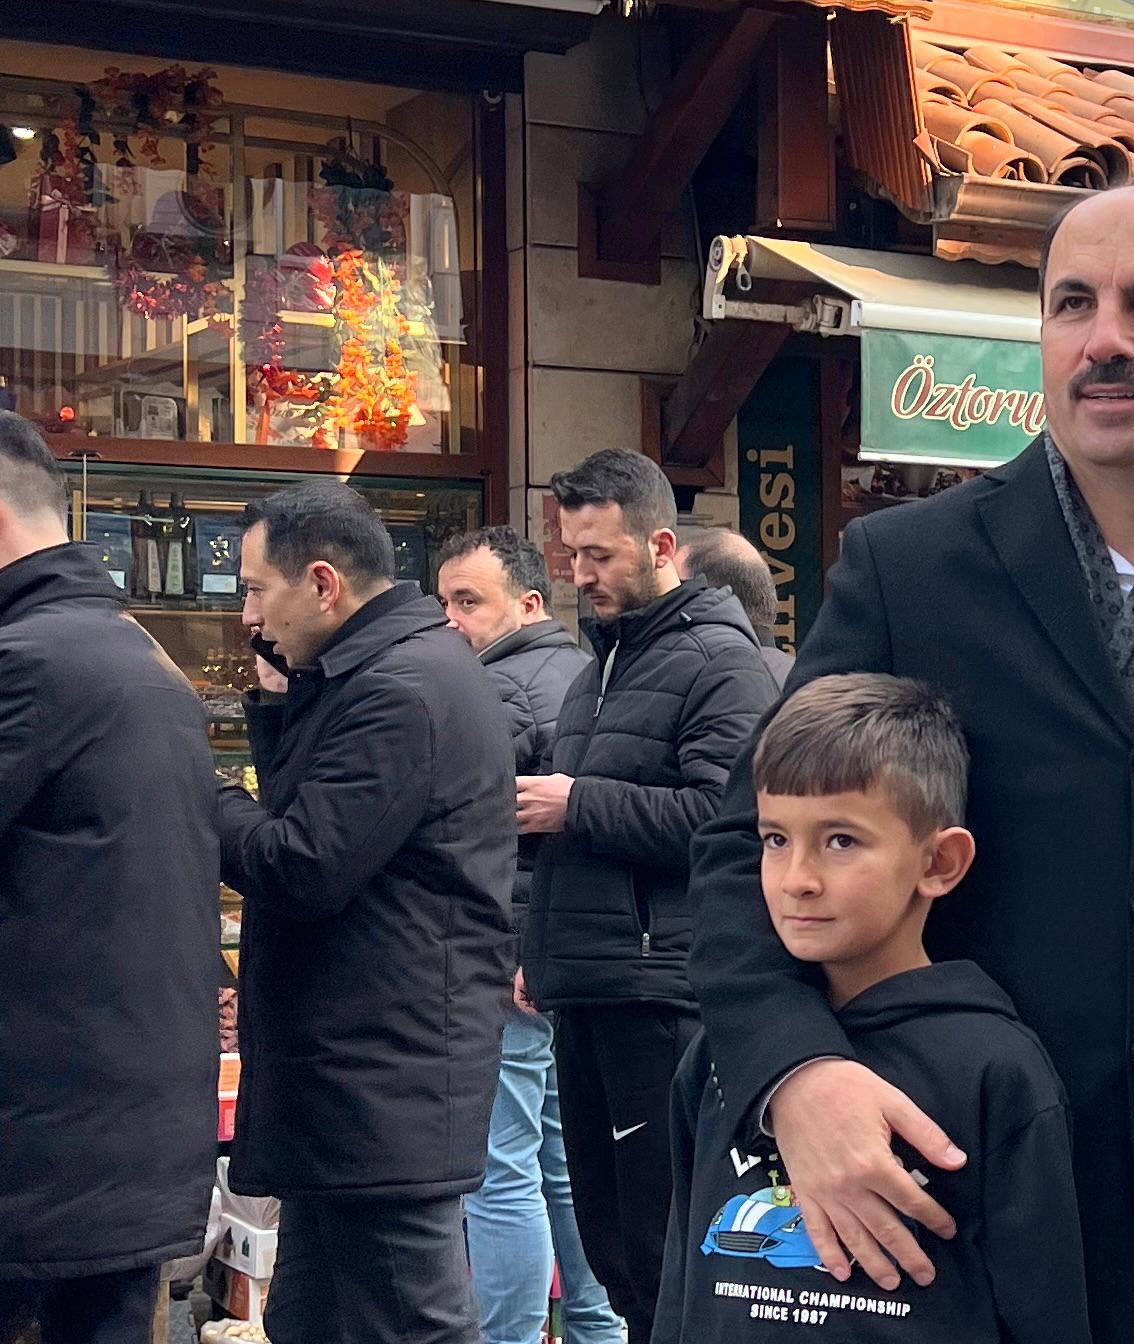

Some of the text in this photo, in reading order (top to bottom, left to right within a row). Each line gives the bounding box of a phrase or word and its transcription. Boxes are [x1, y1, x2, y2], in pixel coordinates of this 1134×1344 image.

[746, 444, 797, 657] vesi
[750, 1303, 828, 1326] SINCE 1987
[799, 1290, 911, 1318] CHAMPIONSHIP
